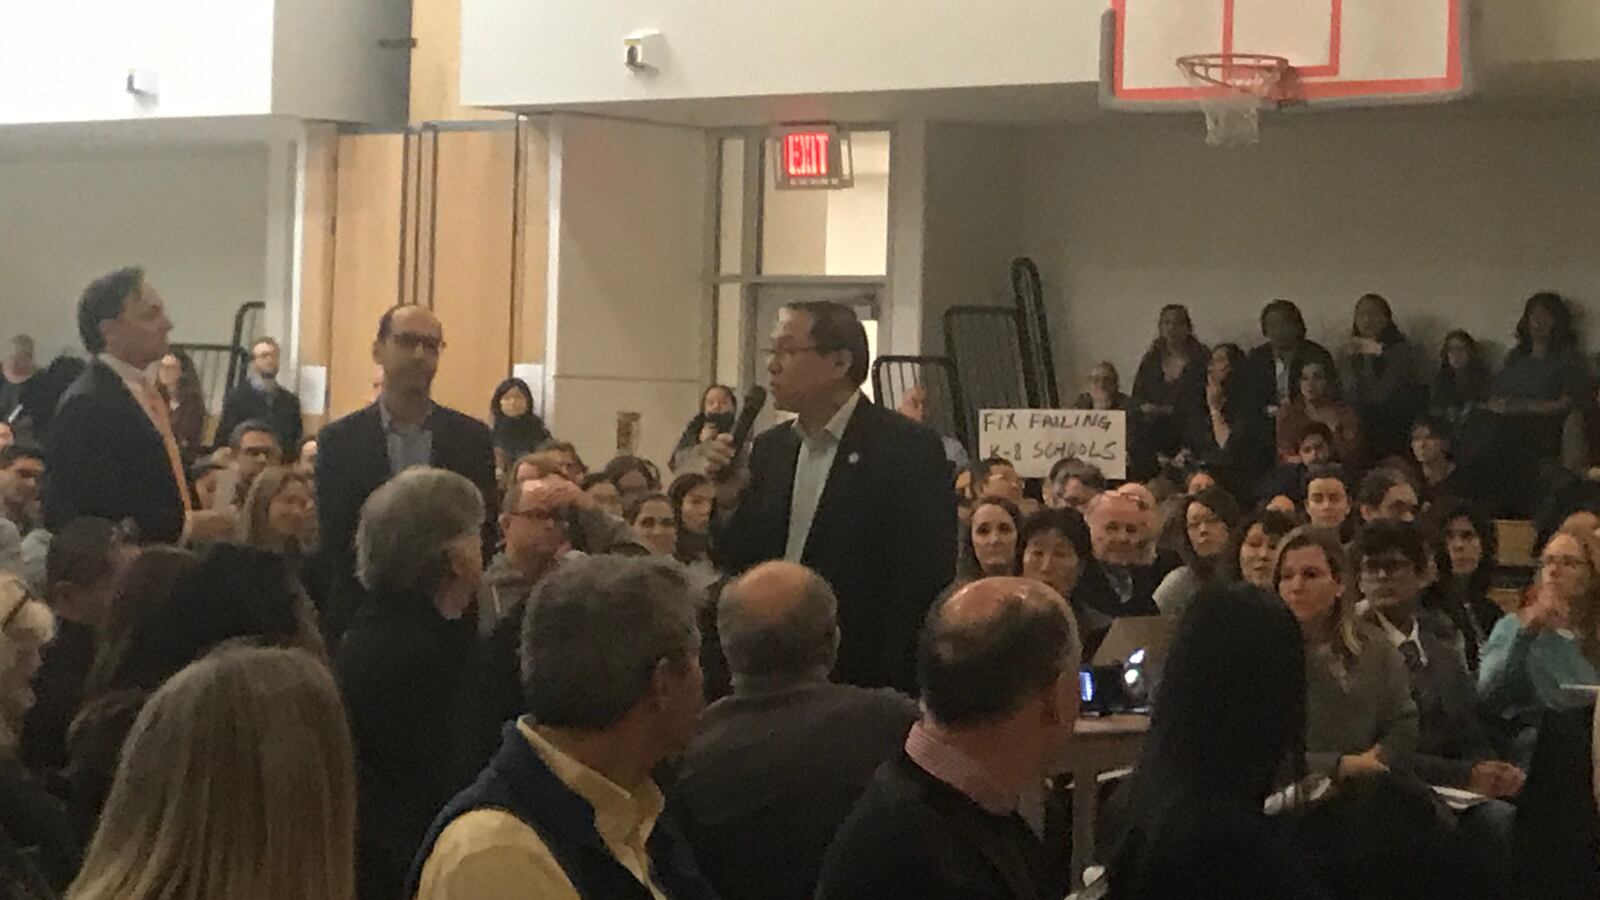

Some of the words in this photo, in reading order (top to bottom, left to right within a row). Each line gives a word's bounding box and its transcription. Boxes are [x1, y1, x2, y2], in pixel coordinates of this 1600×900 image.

[786, 133, 829, 176] EXIT
[983, 413, 1017, 432] FIX
[1028, 413, 1112, 431] FAILING
[989, 443, 1022, 461] K-8
[1032, 440, 1117, 461] SCHOOLS
